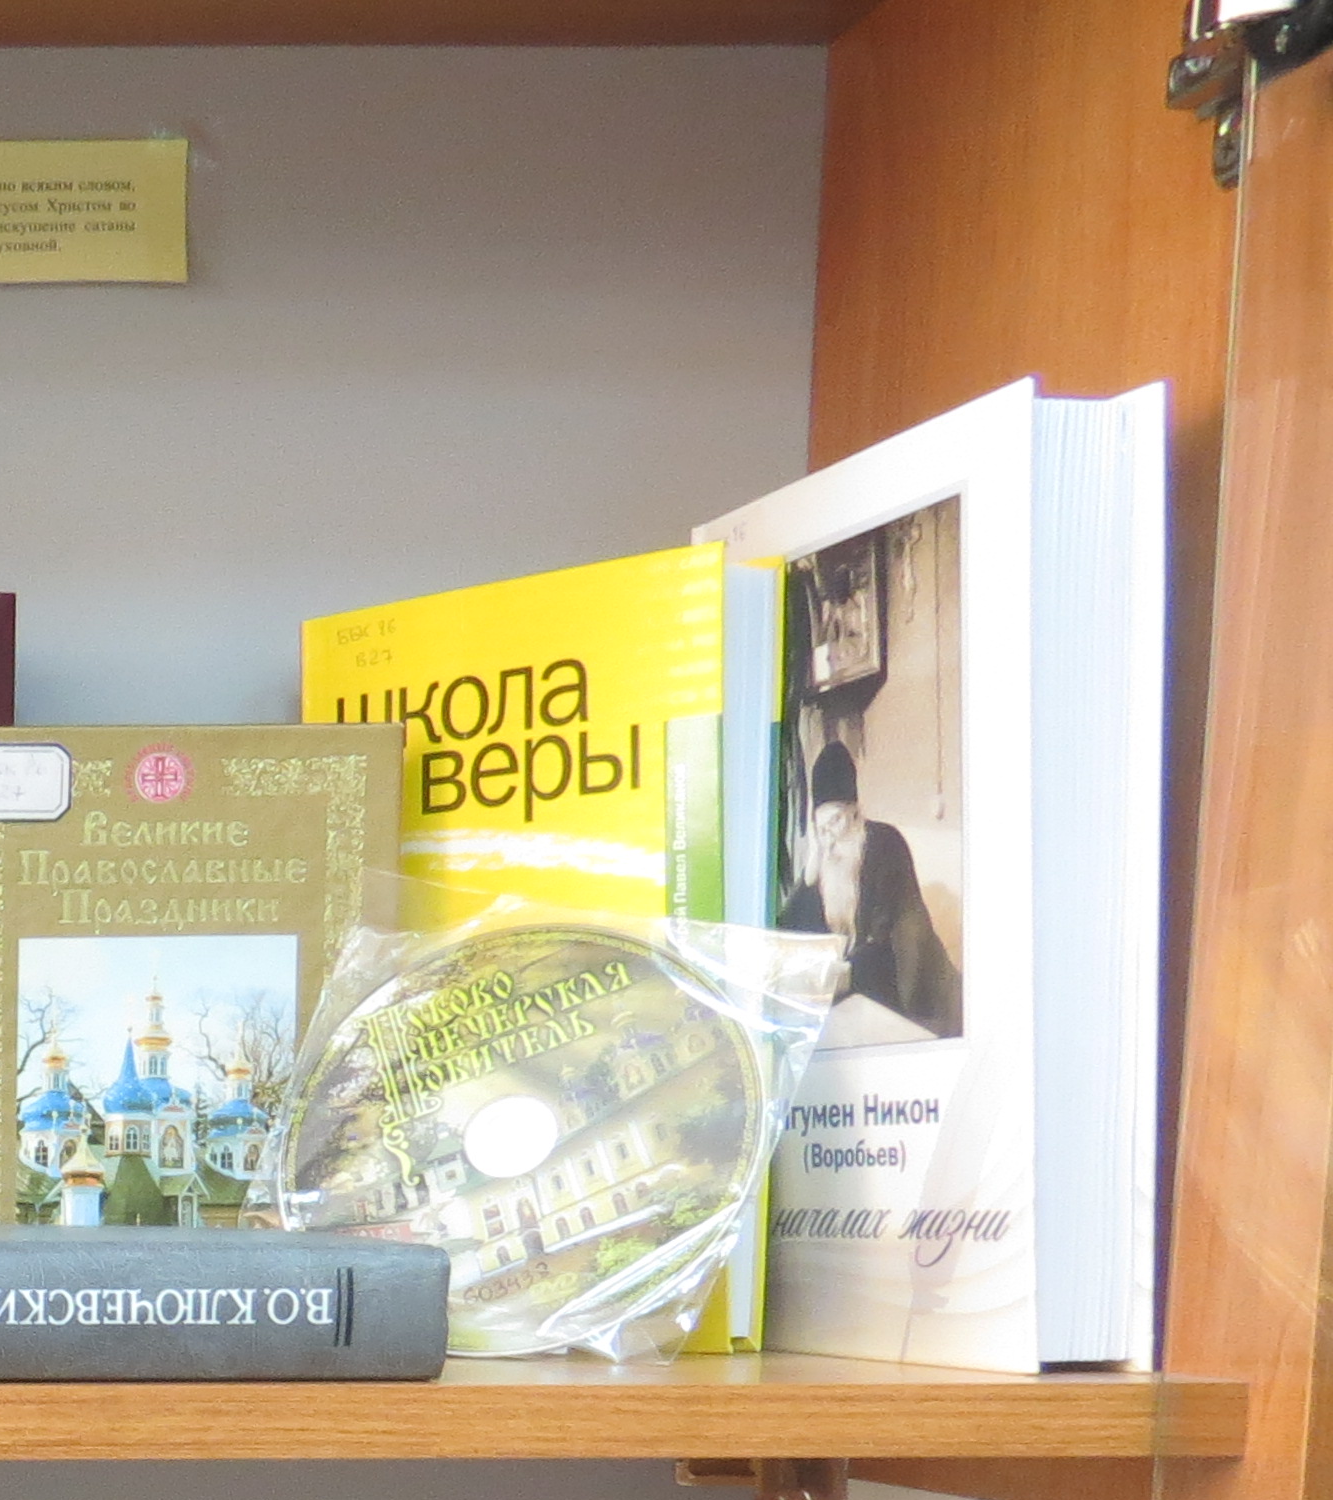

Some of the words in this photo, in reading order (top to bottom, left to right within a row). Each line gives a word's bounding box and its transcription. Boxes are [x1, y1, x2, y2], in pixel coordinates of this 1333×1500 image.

[422, 725, 641, 822] веры
[83, 811, 249, 848] Великие
[18, 850, 308, 896] Православные
[59, 889, 279, 934] Праздники
[863, 1094, 939, 1128] Никон
[803, 1140, 906, 1173] (Воробьев)
[772, 1208, 891, 1240] началах
[898, 1208, 1010, 1268] жизни
[263, 1287, 334, 1326] В.О.
